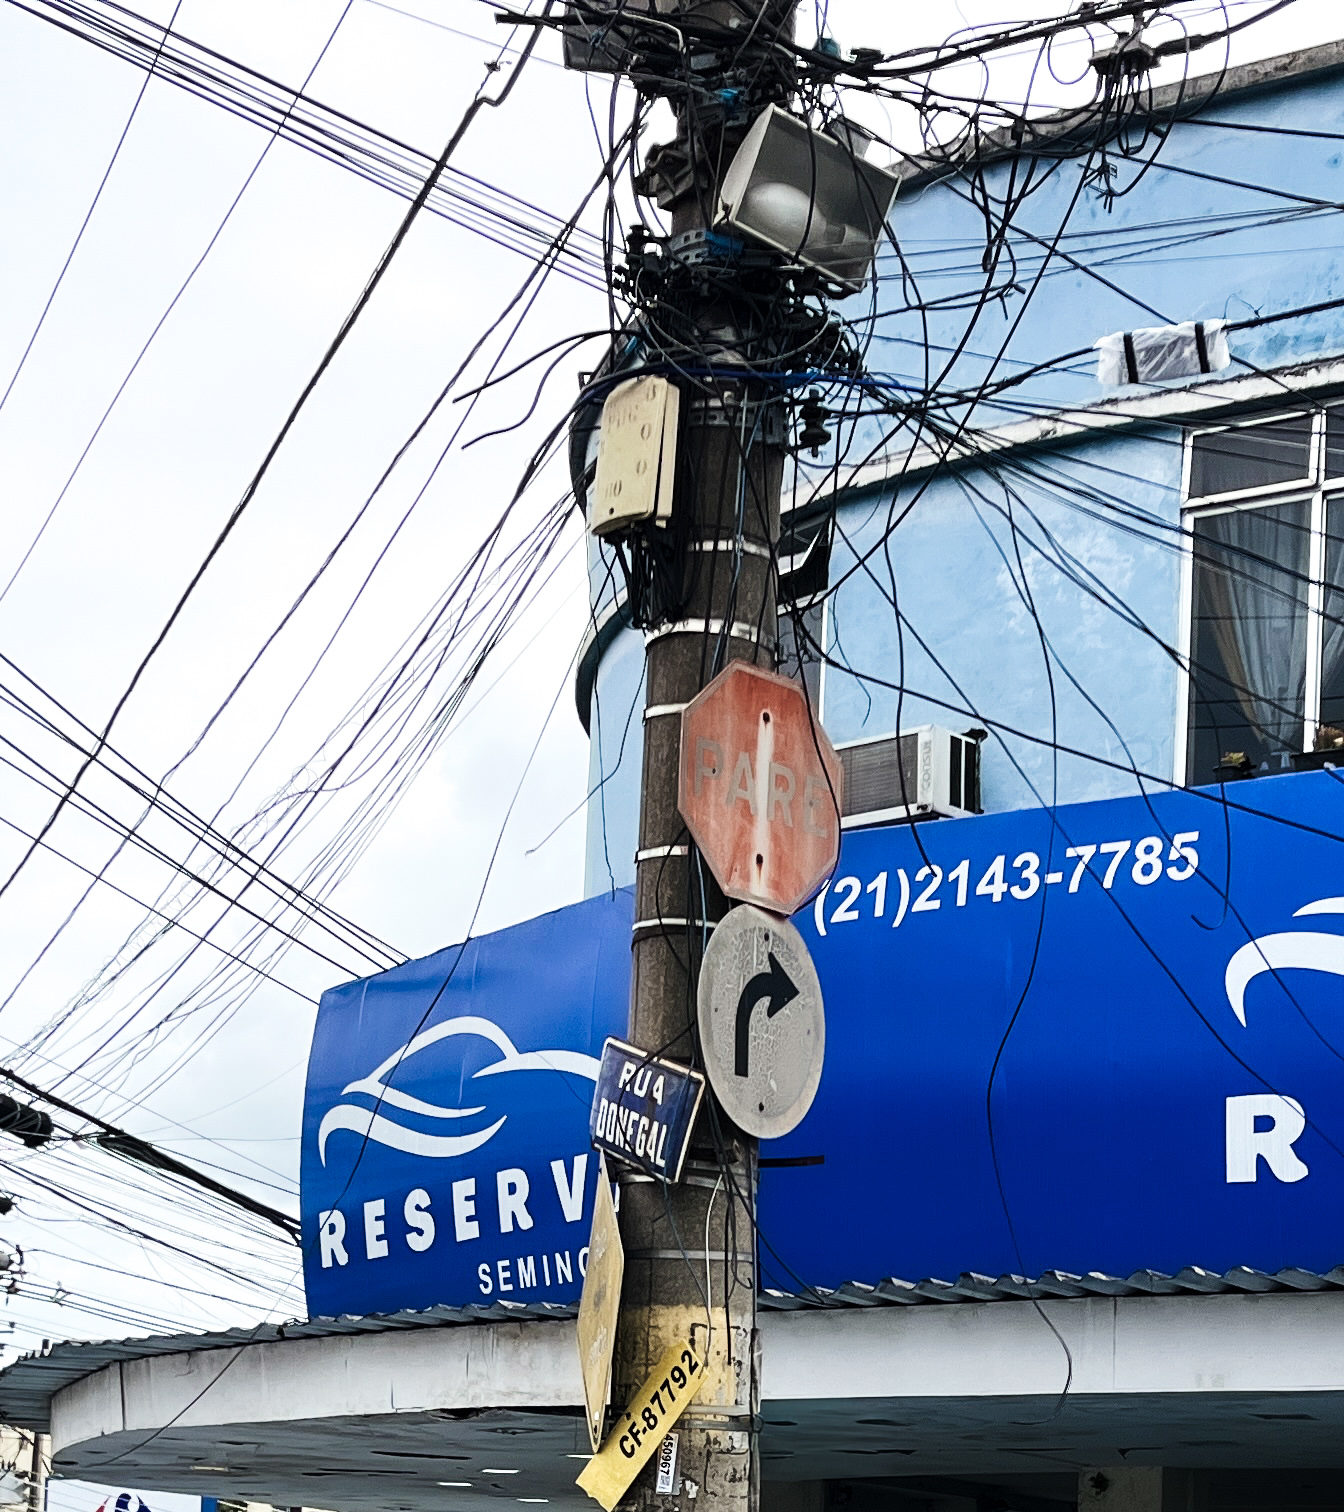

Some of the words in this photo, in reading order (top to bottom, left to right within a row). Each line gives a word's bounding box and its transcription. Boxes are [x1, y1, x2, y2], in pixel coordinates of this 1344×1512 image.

[693, 735, 830, 839] PARE
[813, 830, 1200, 937] (21)2143-7785
[596, 1097, 668, 1169] DONEGAL
[618, 1060, 666, 1106] RUA
[318, 1153, 619, 1269] RESERV
[619, 1349, 699, 1459] CF-87792
[660, 1433, 674, 1476] 450967
